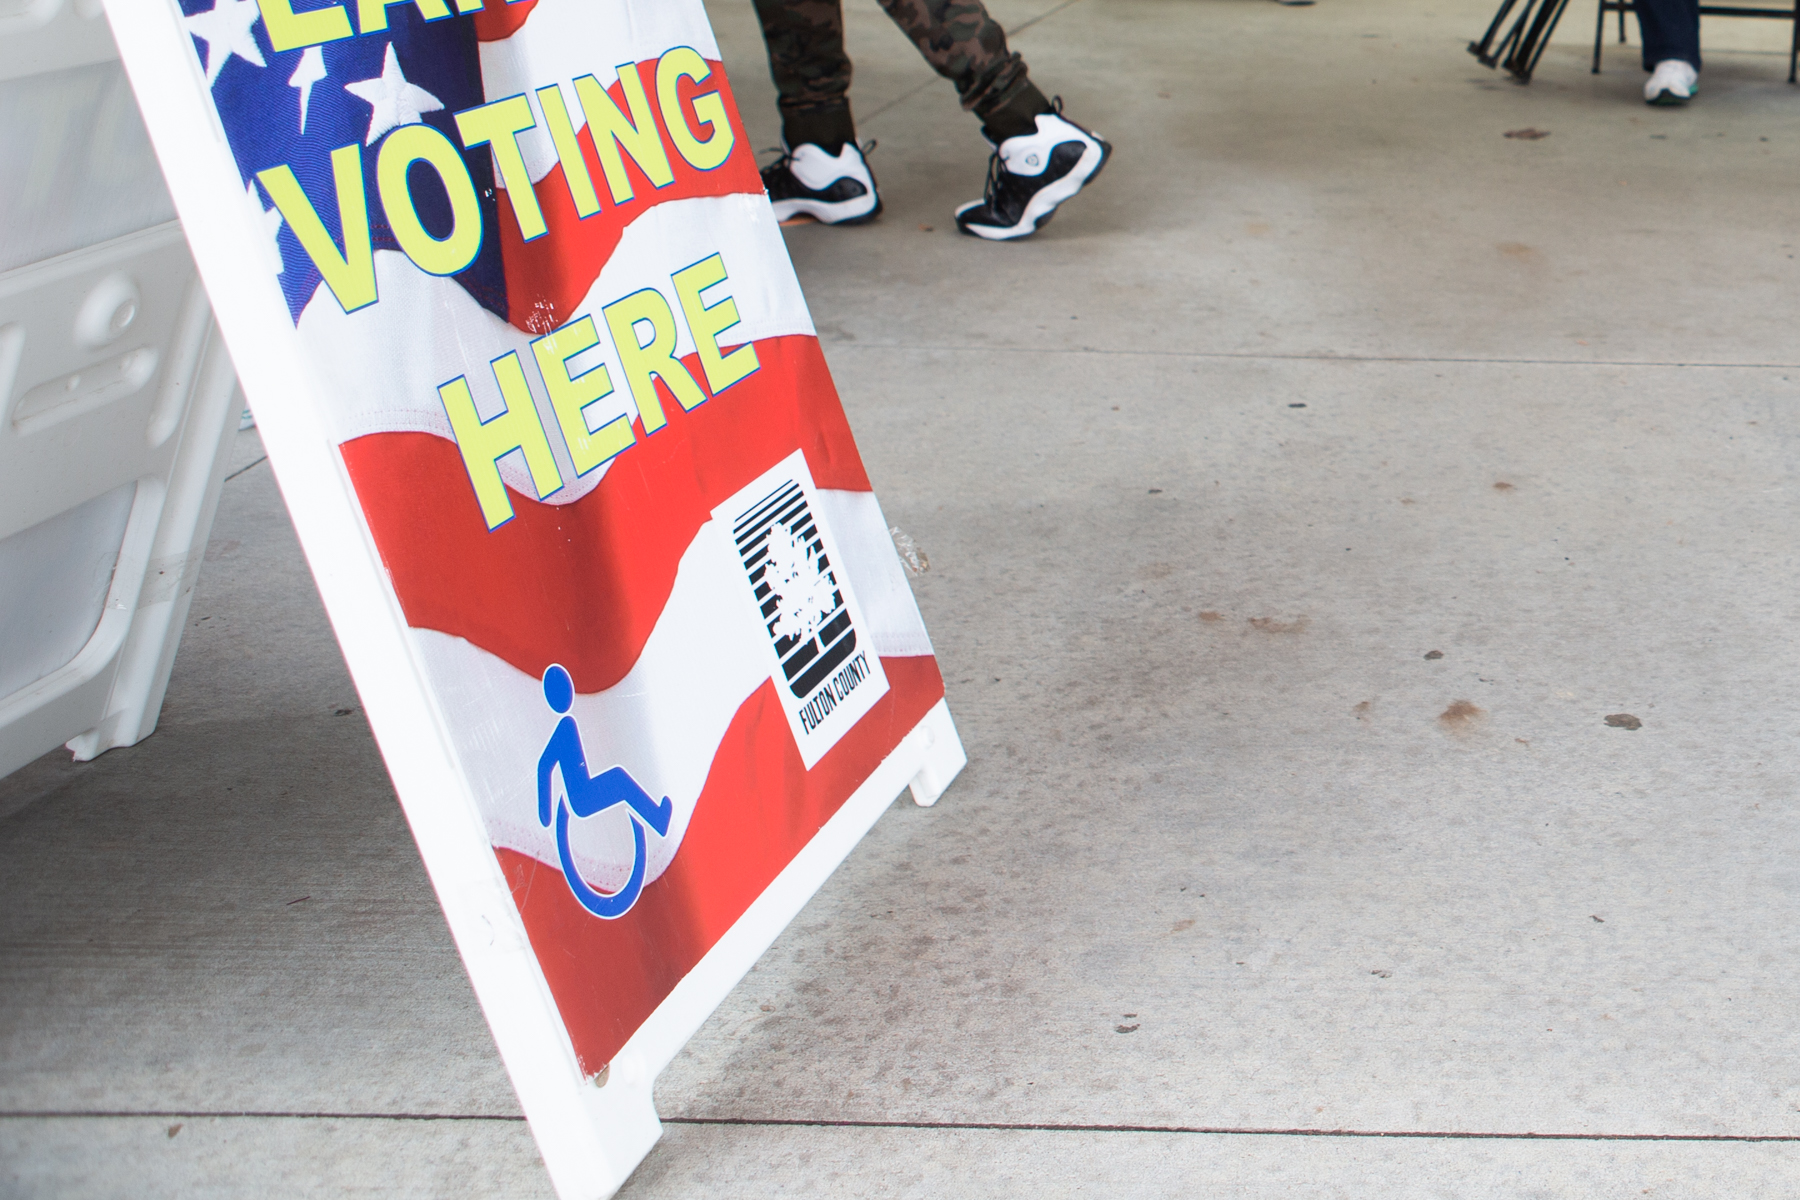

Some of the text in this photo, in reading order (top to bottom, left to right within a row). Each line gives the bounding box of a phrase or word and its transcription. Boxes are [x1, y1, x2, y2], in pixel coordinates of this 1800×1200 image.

[256, 45, 736, 315] VOTING
[437, 252, 762, 533] HERE
[799, 650, 871, 735] FULTON COUNTY
